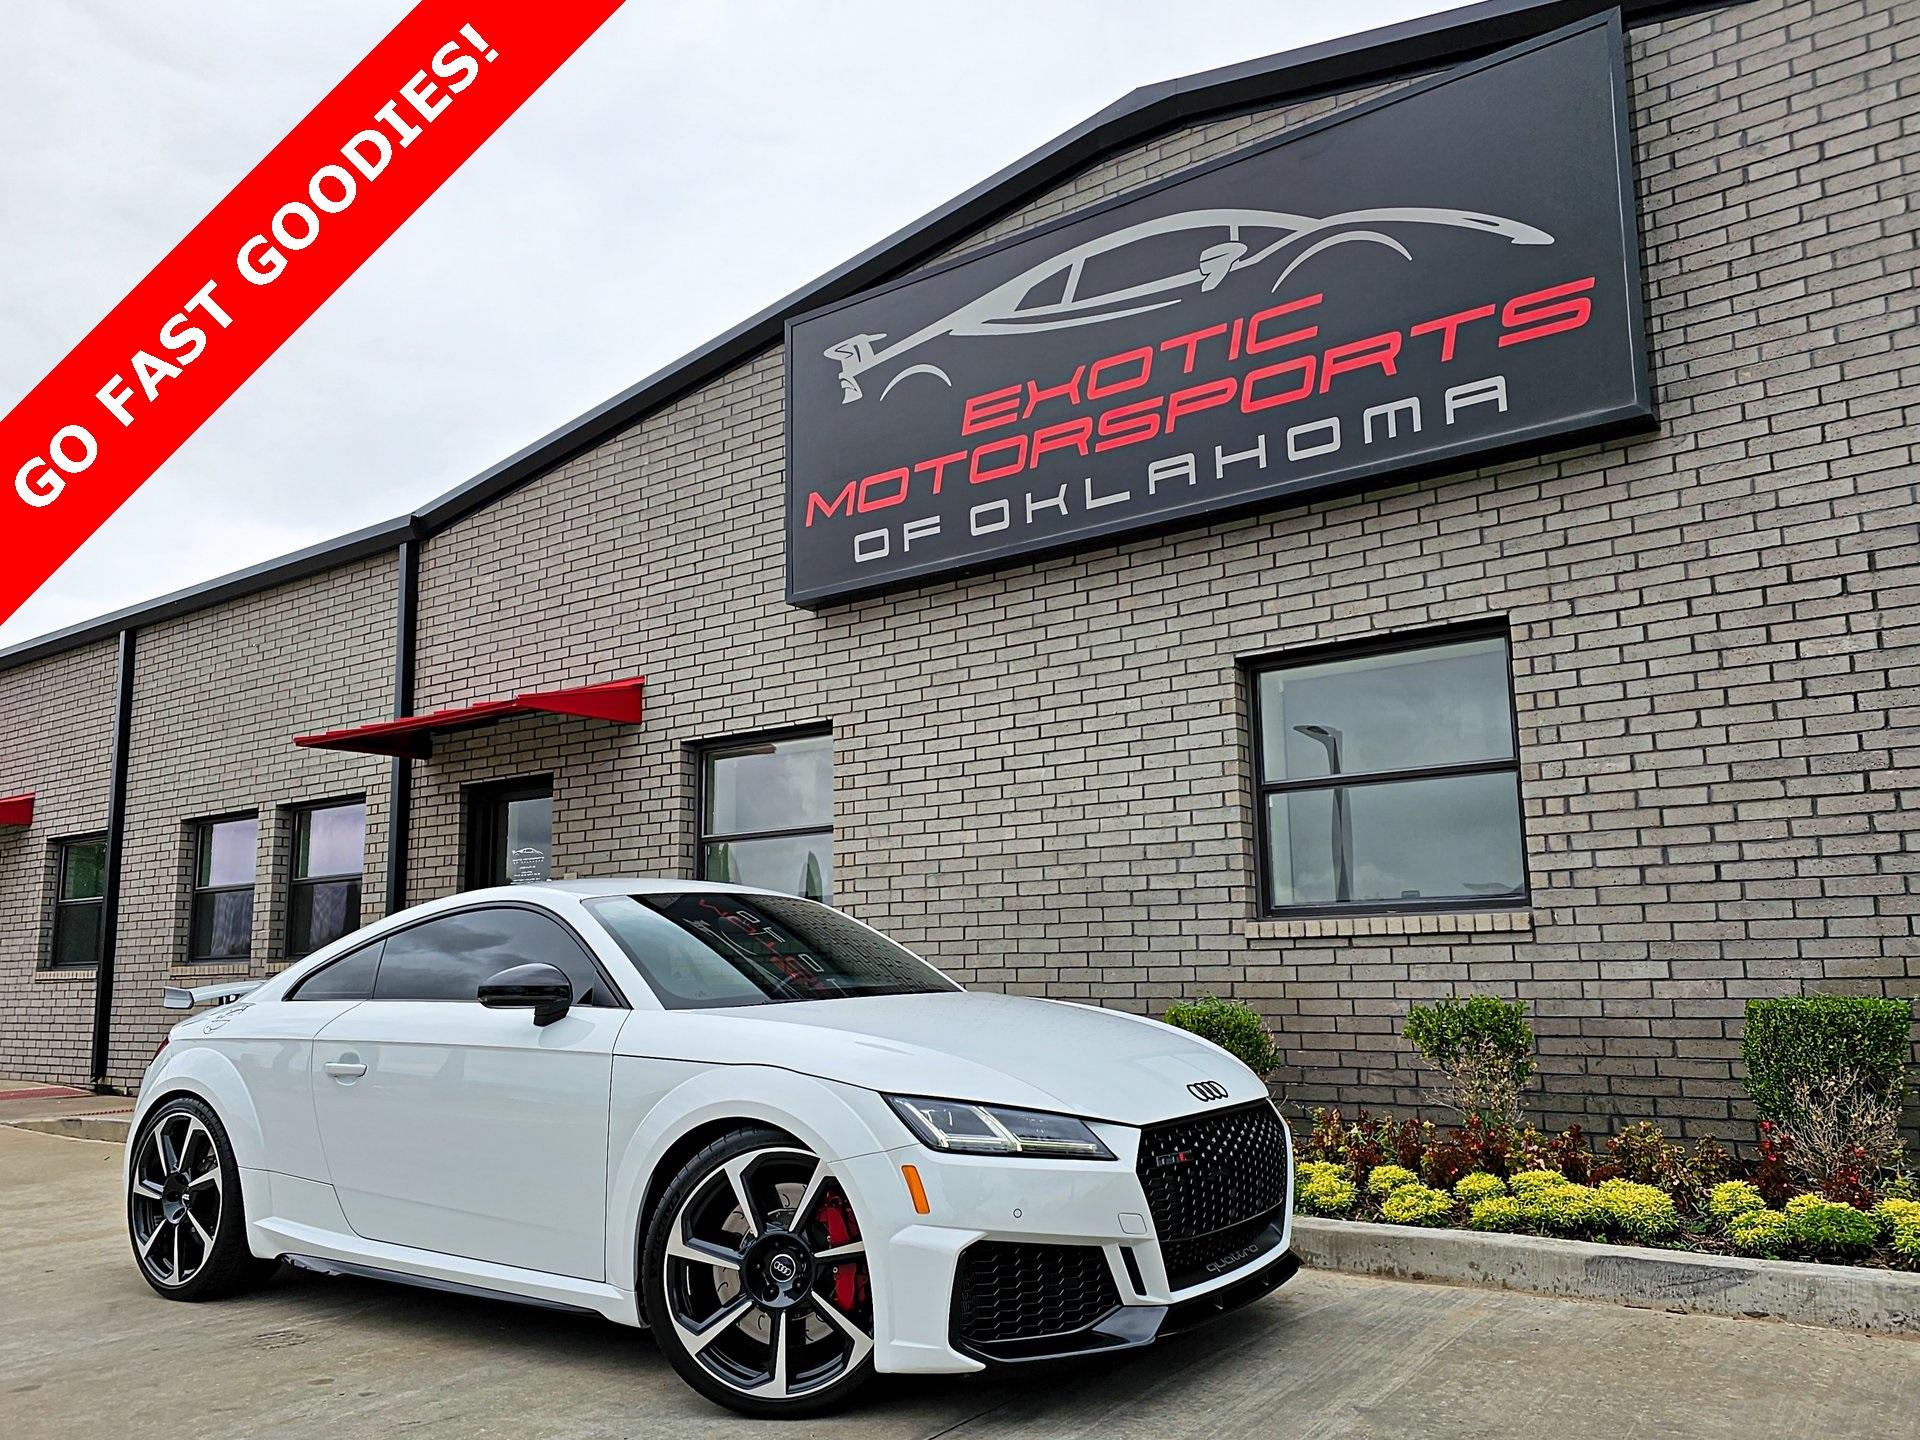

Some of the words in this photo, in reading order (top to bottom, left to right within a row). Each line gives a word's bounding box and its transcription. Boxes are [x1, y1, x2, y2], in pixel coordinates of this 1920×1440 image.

[804, 276, 1596, 528] MOTORSPORTS
[961, 293, 1324, 437] EXOTIC
[853, 514, 941, 563] OF
[969, 375, 1509, 537] OKLAHOMA
[1206, 1244, 1259, 1273] quattro
